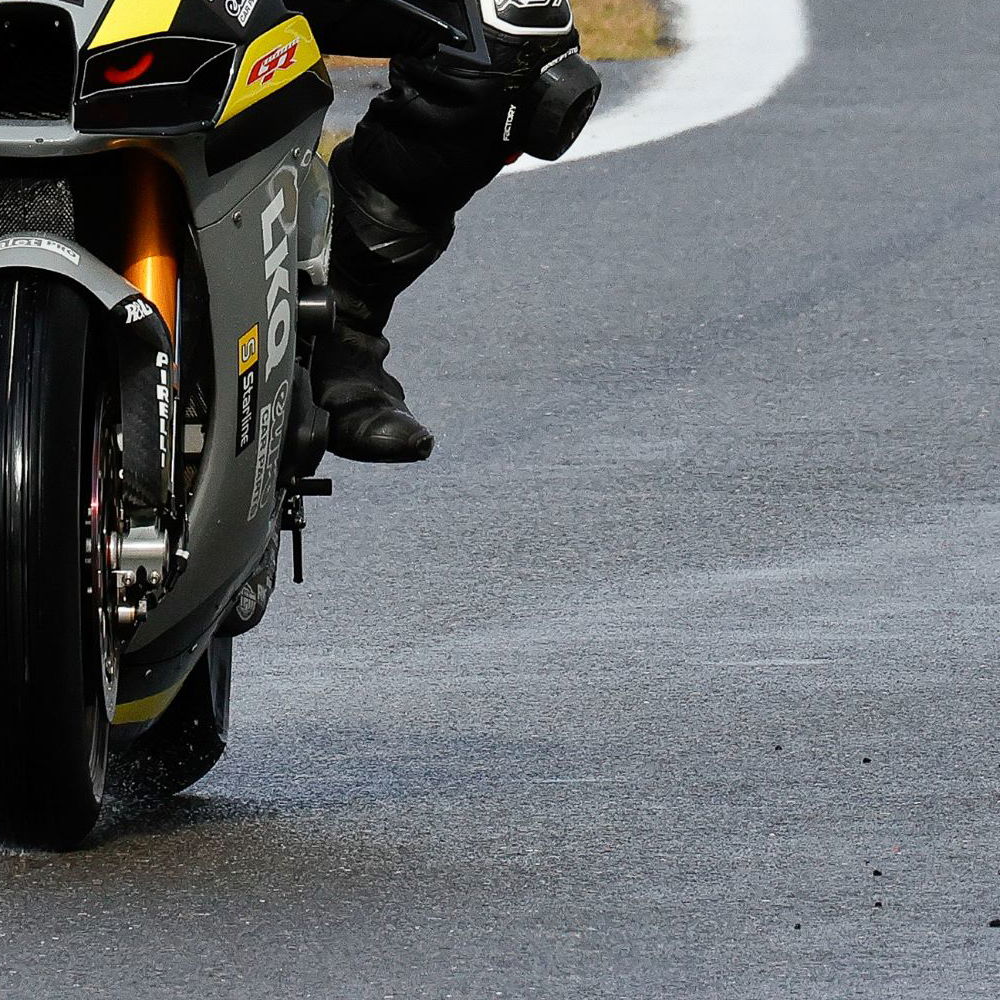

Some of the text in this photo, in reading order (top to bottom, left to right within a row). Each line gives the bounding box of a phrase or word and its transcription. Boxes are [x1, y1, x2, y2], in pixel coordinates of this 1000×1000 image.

[240, 5, 250, 22] CAR
[261, 188, 291, 383] LKQ
[156, 352, 169, 468] PIRELLI
[240, 371, 254, 447] Starline
